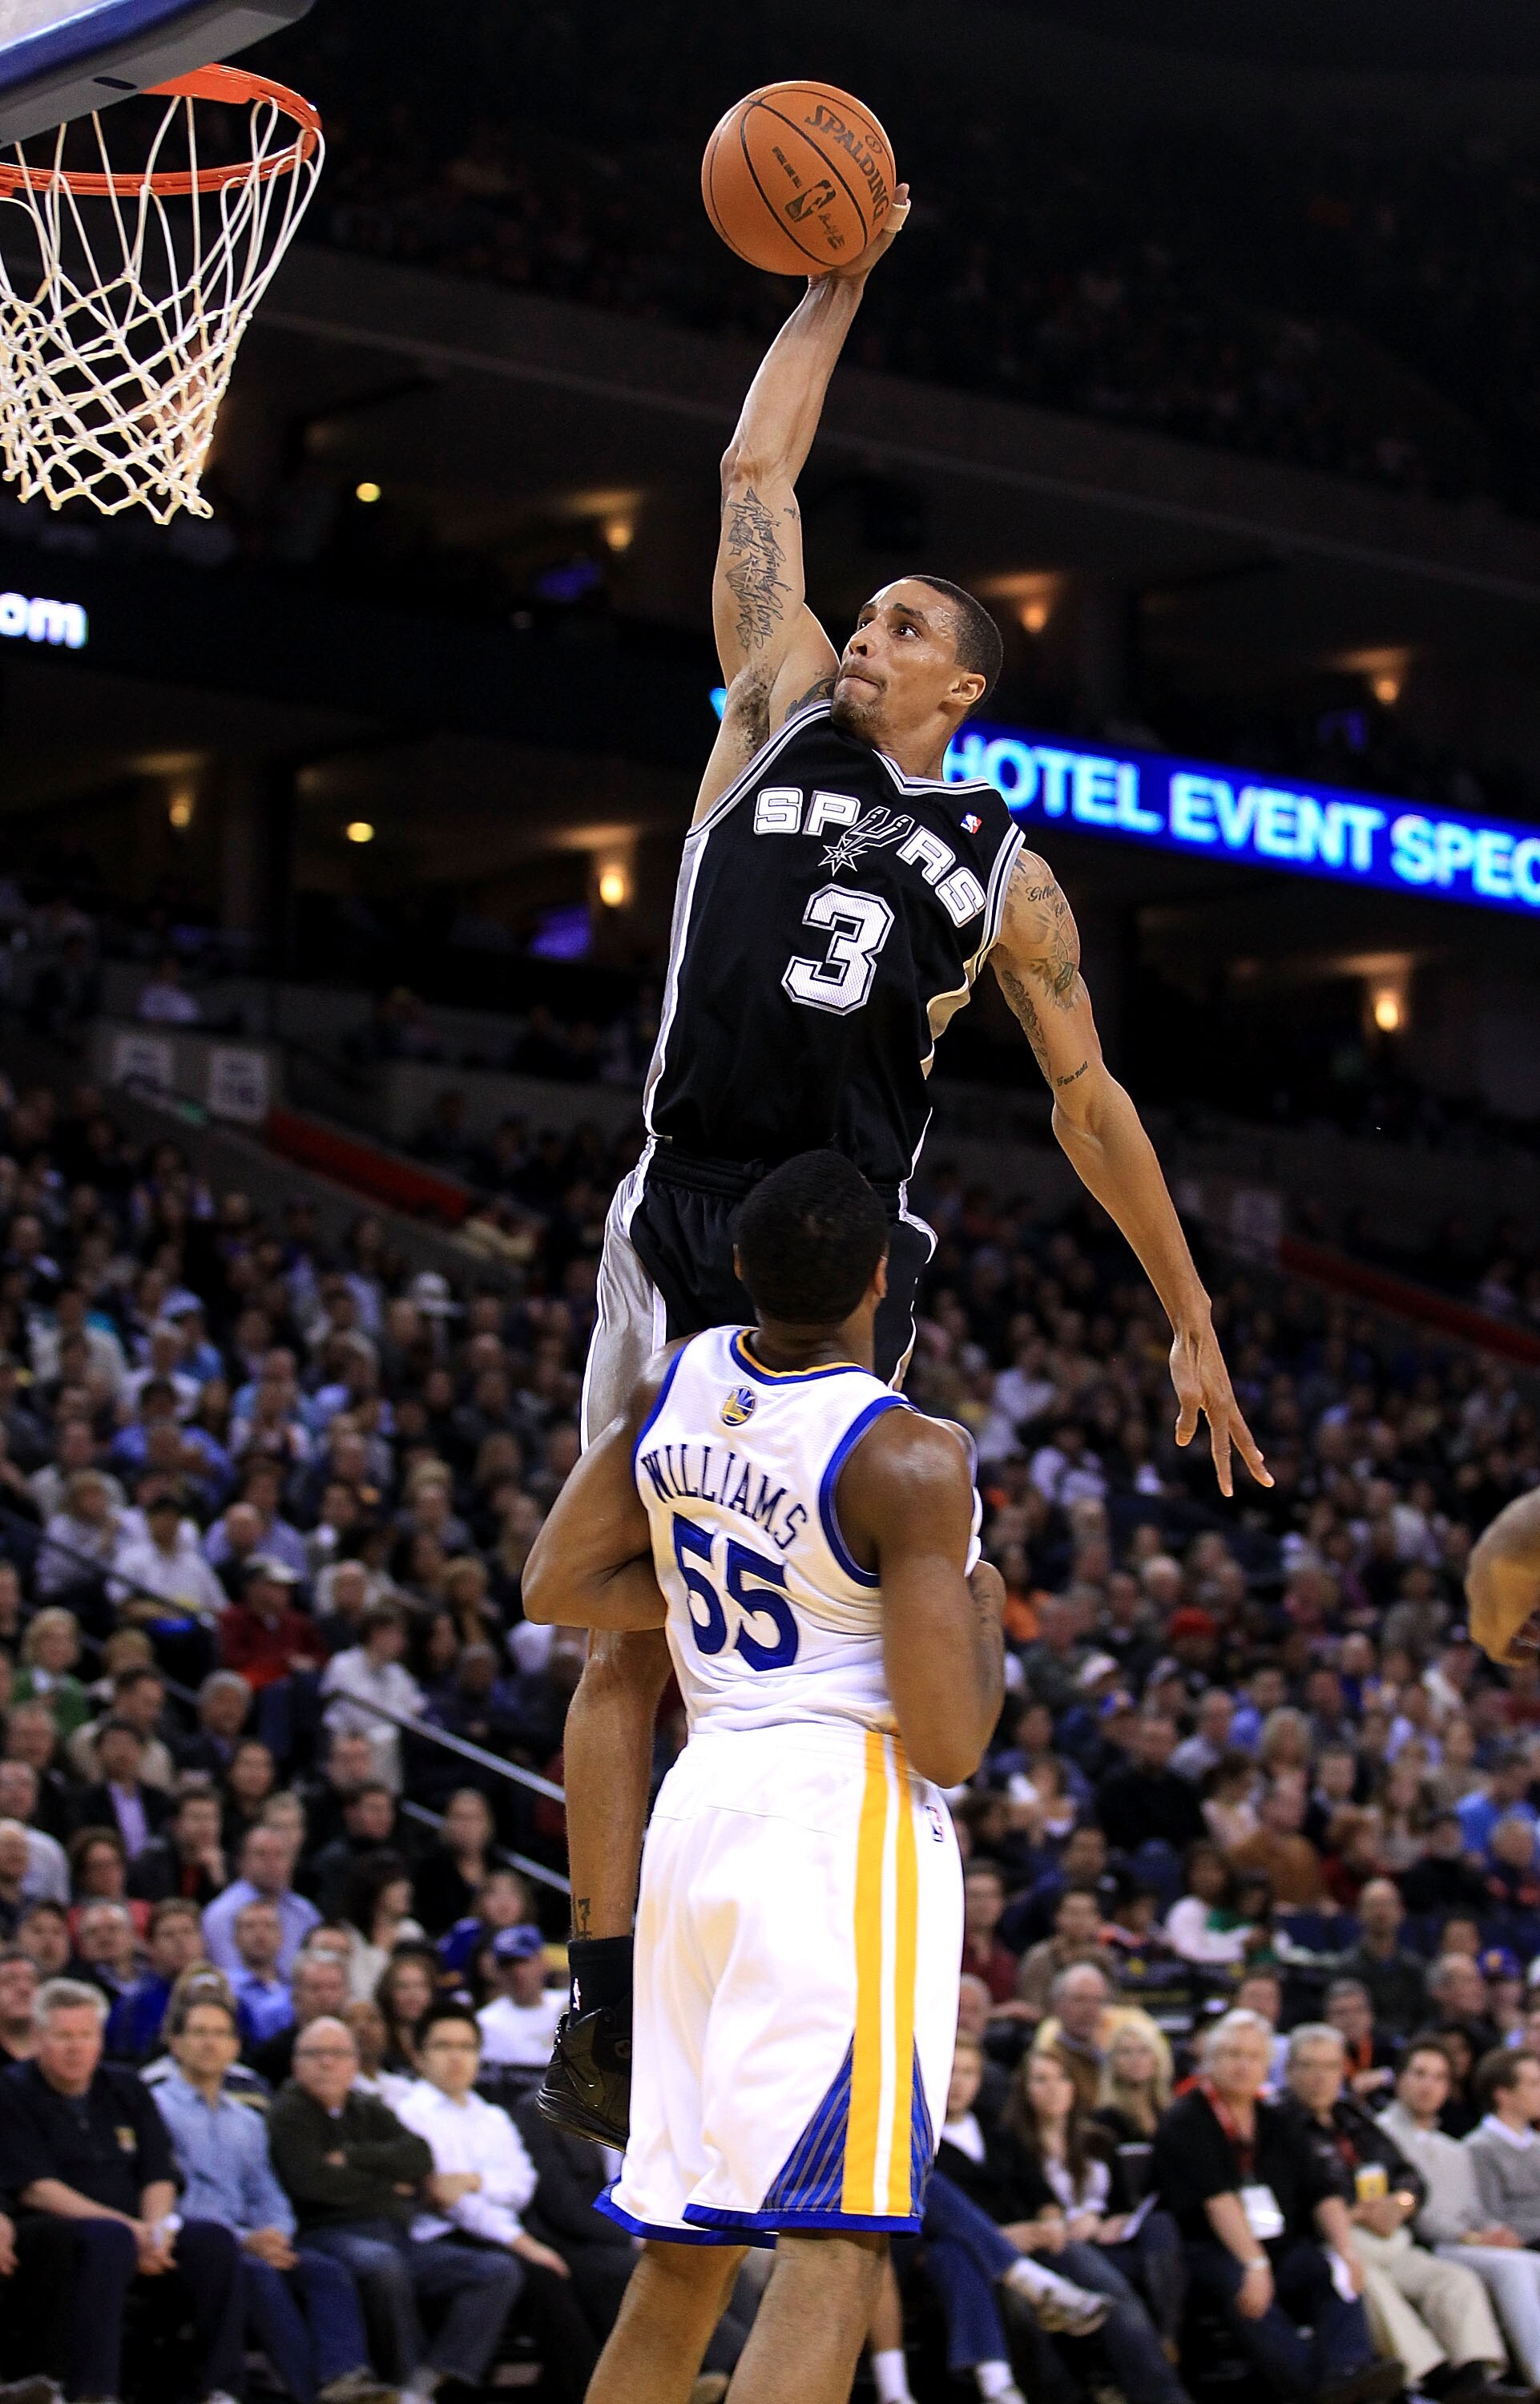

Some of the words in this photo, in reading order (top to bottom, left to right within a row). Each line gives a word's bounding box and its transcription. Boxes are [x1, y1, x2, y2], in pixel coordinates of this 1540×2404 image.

[804, 105, 889, 225] SPALDING
[753, 787, 987, 928] SPURS
[943, 732, 1163, 833] HOTEL
[1169, 770, 1385, 871] EVENT
[781, 883, 895, 1016] 3
[641, 1443, 807, 1550] WILLIAMS
[672, 1511, 800, 1672] 55
